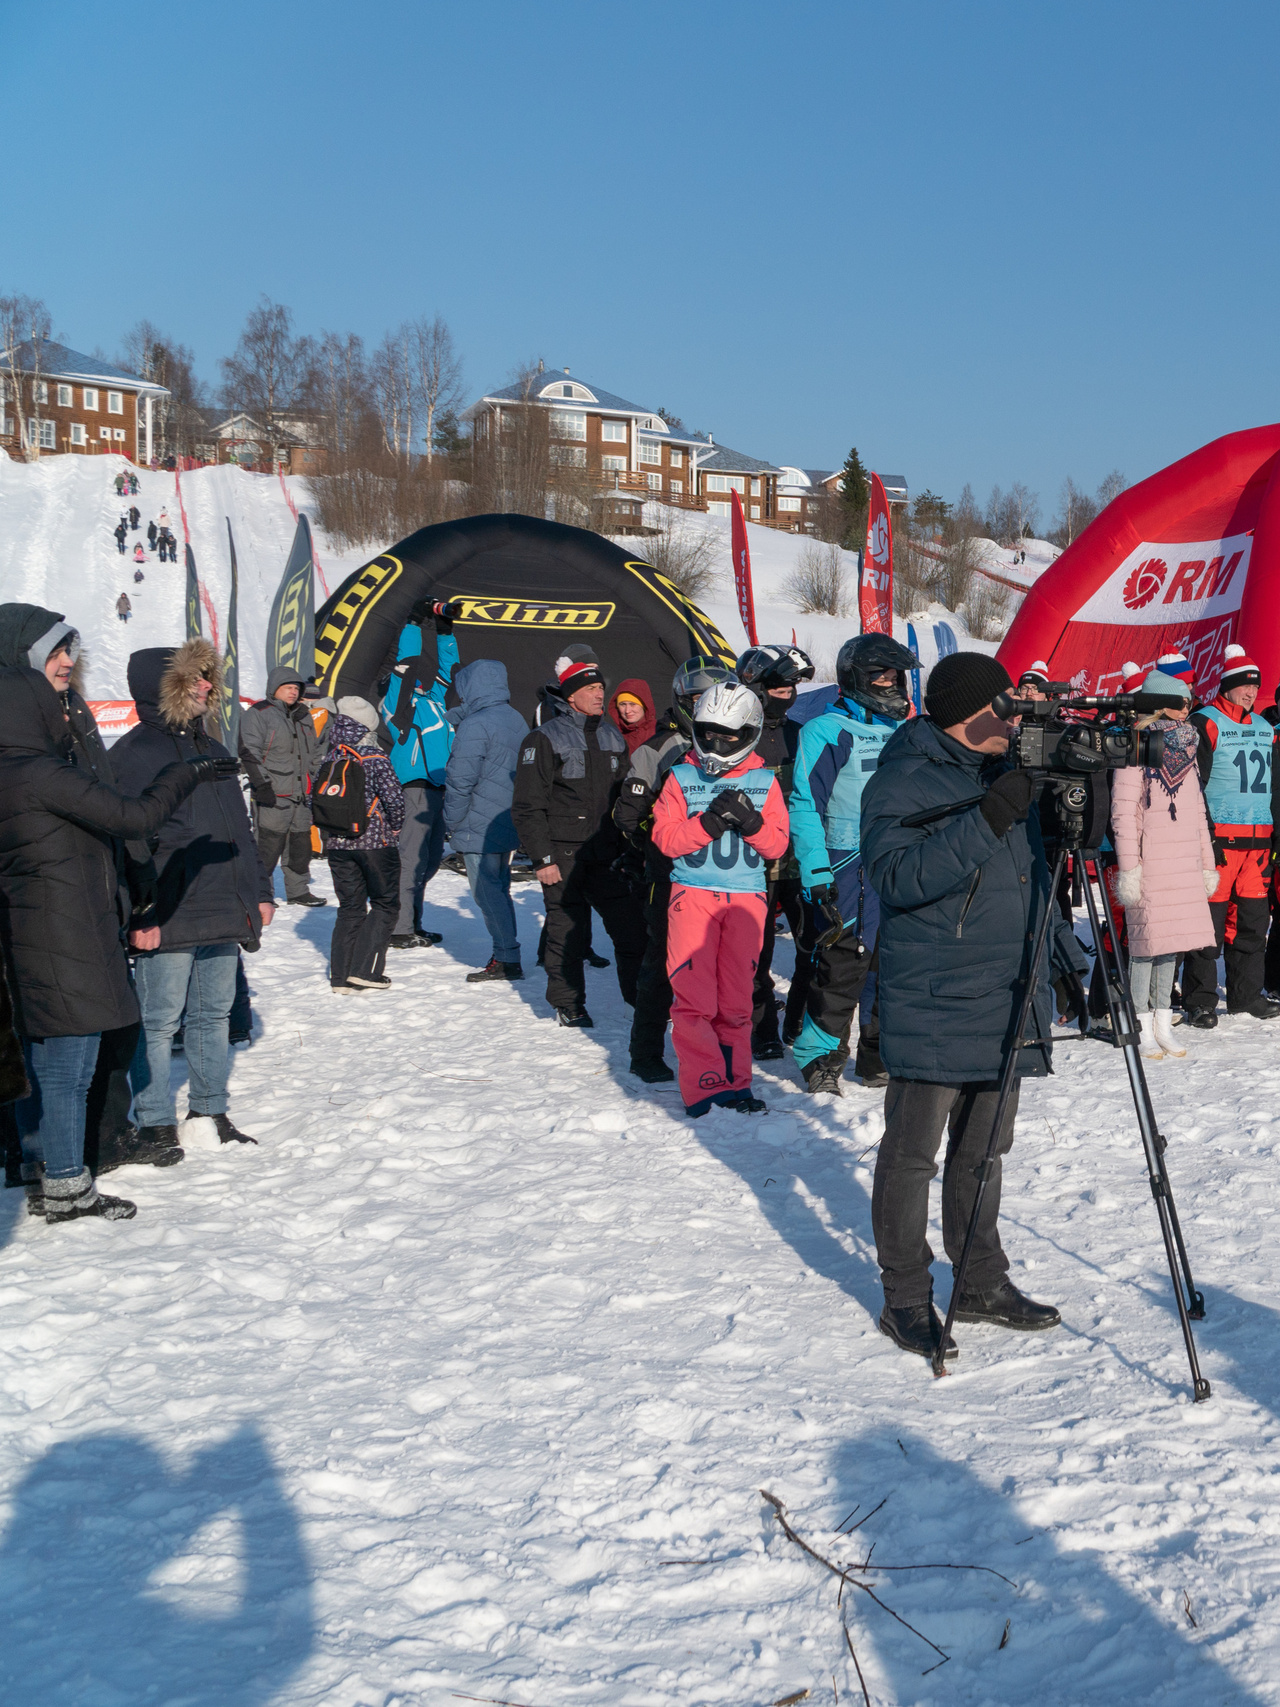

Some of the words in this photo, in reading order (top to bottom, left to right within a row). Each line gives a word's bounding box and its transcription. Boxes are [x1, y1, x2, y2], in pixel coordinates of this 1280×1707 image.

[1162, 550, 1245, 604] RM
[315, 564, 392, 687] lim
[460, 600, 600, 625] Klim
[1076, 753, 1096, 763] SONY
[1232, 750, 1272, 793] 12
